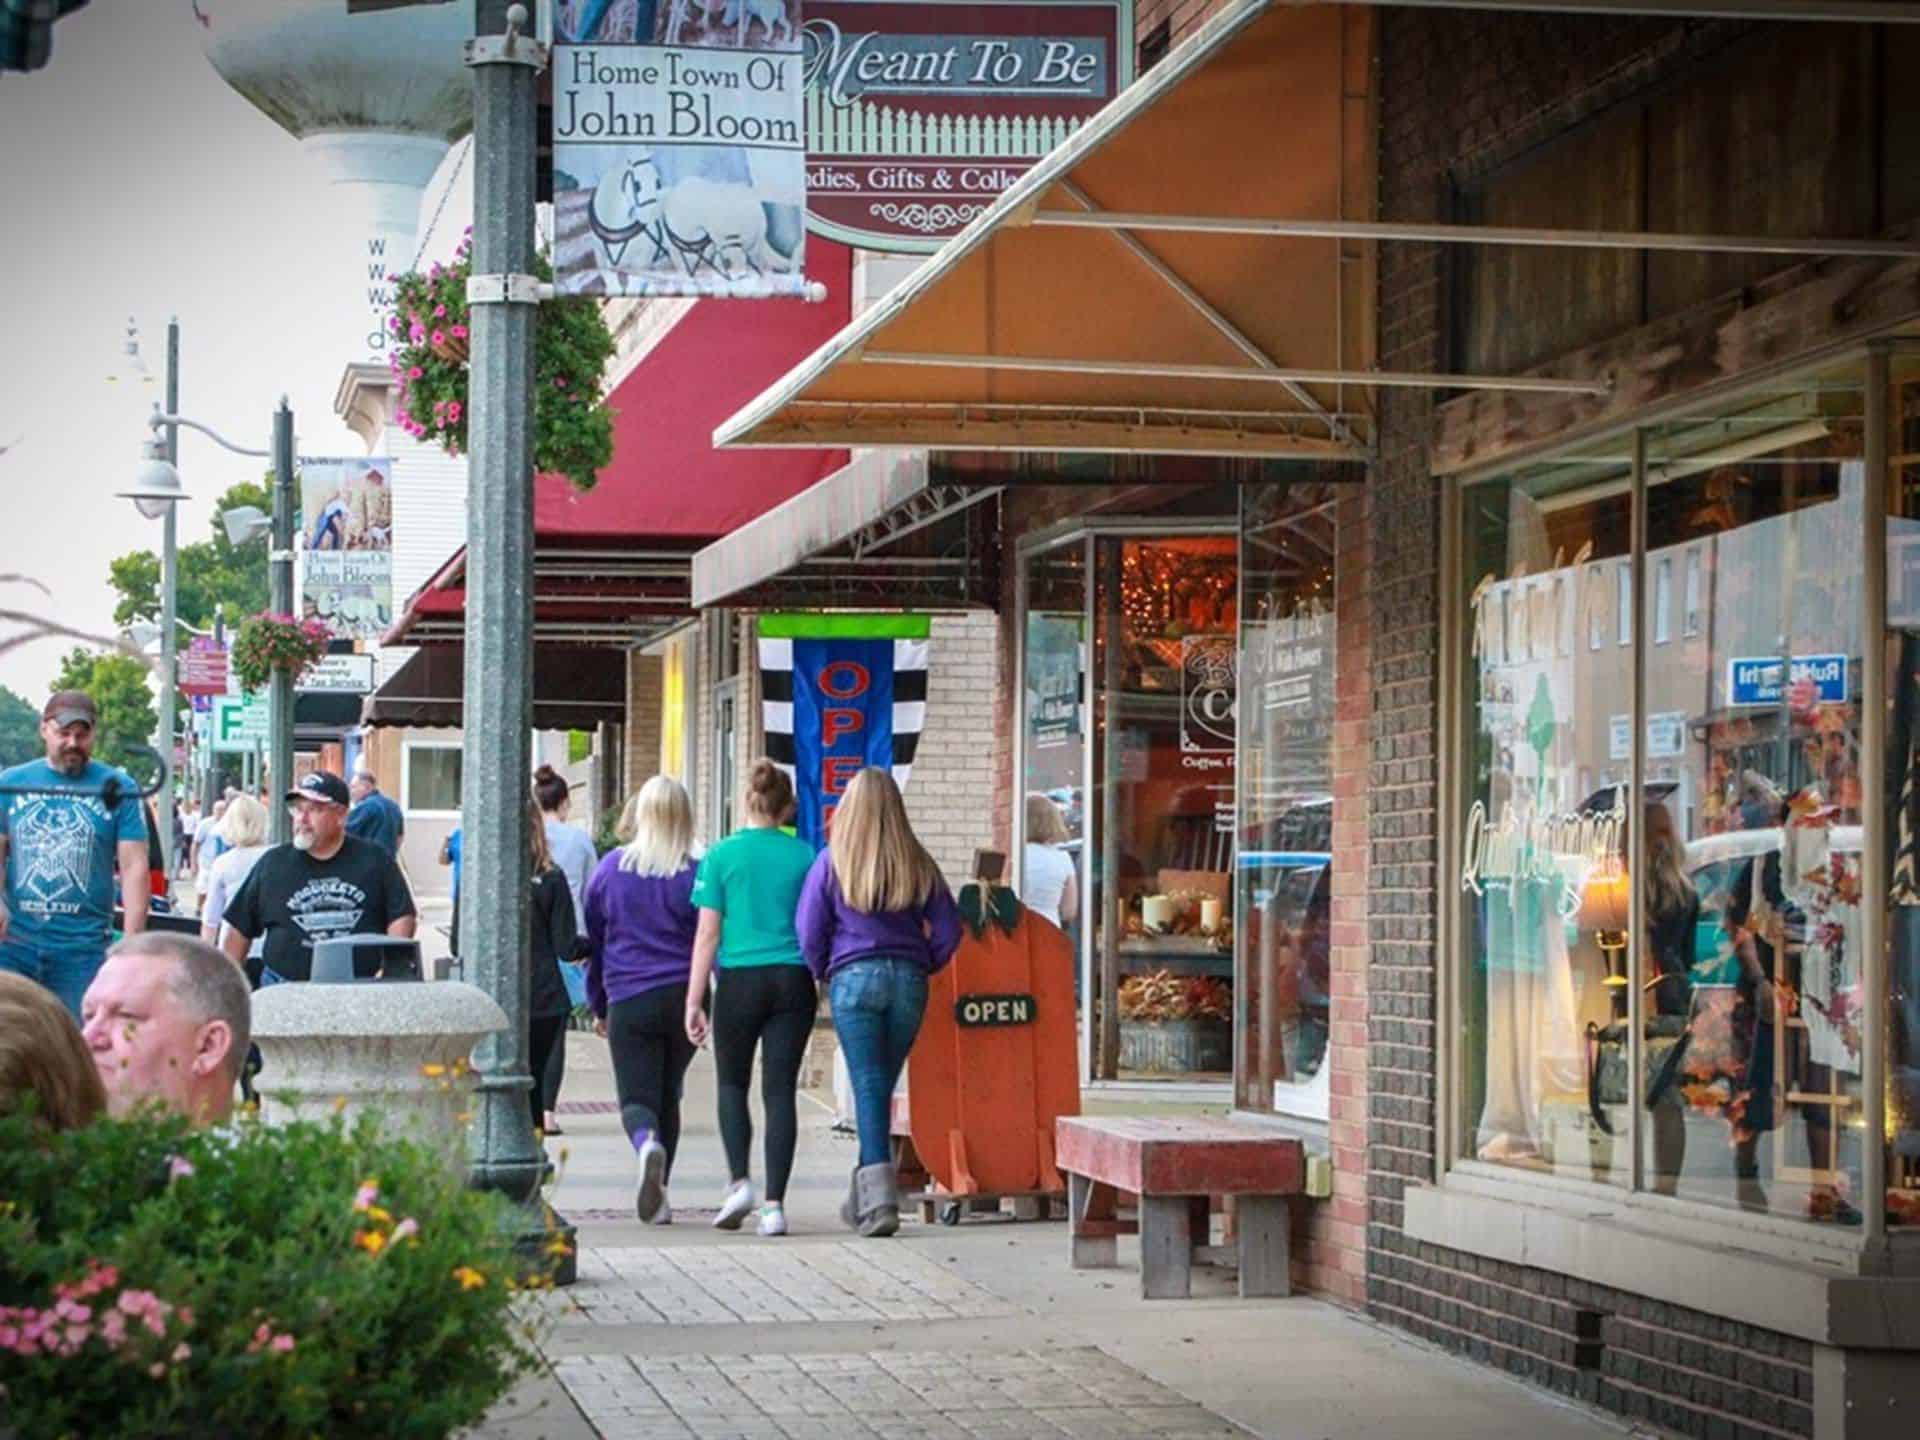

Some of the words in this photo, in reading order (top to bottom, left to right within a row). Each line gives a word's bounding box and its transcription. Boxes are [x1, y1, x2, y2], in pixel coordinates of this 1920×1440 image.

[571, 51, 658, 85] Home
[664, 52, 740, 89] Town
[746, 57, 785, 92] Of
[802, 19, 959, 108] Meant
[970, 41, 1022, 83] To
[1032, 41, 1097, 83] Be
[557, 90, 656, 137] John
[668, 91, 799, 142] Bloom
[867, 167, 925, 190] Gifts
[931, 168, 954, 190] &
[304, 565, 340, 584] John
[343, 565, 391, 584] Bloom
[963, 999, 1028, 1022] OPEN
